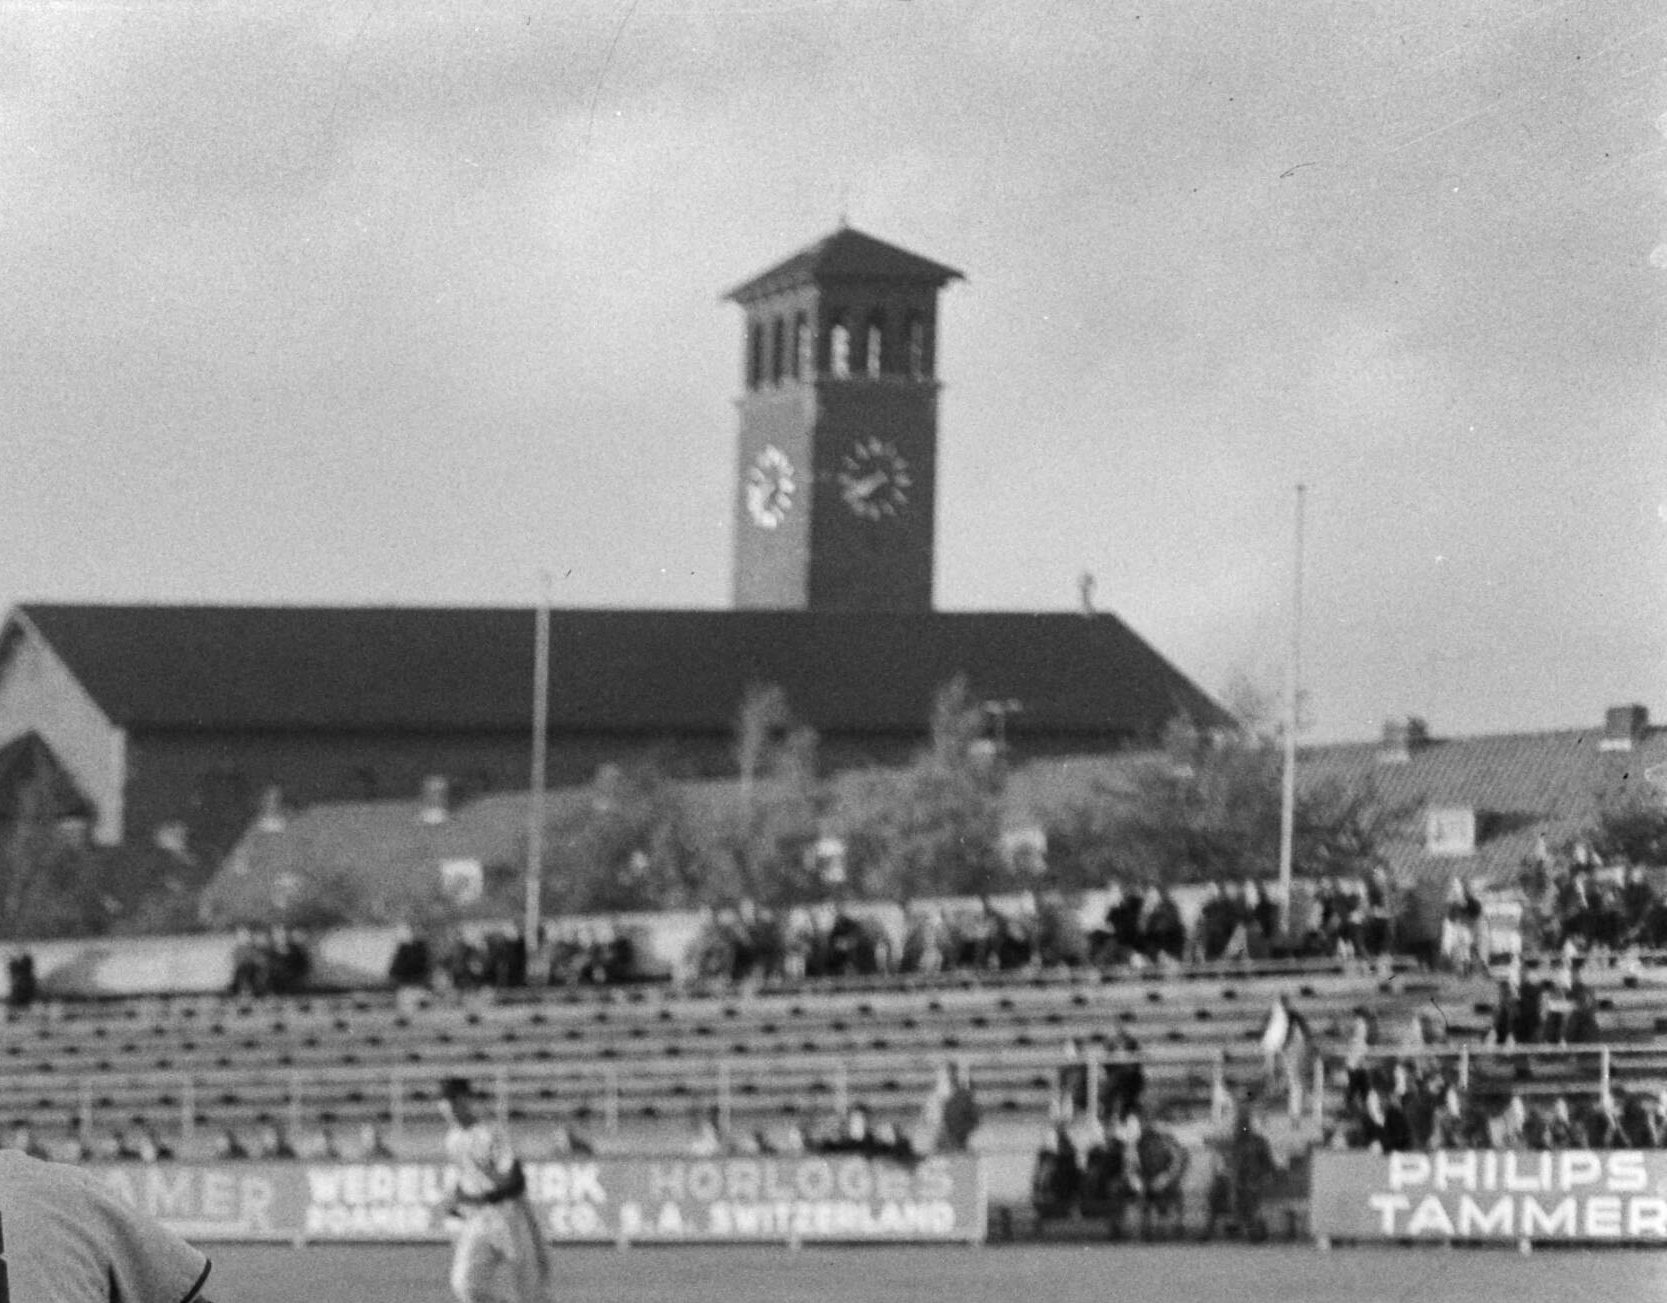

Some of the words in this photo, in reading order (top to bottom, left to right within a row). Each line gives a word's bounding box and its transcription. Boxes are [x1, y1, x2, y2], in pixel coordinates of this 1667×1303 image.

[1388, 1149, 1647, 1192] PHILIPS
[105, 1167, 275, 1232] AMER
[1368, 1194, 1667, 1237] TAMMER
